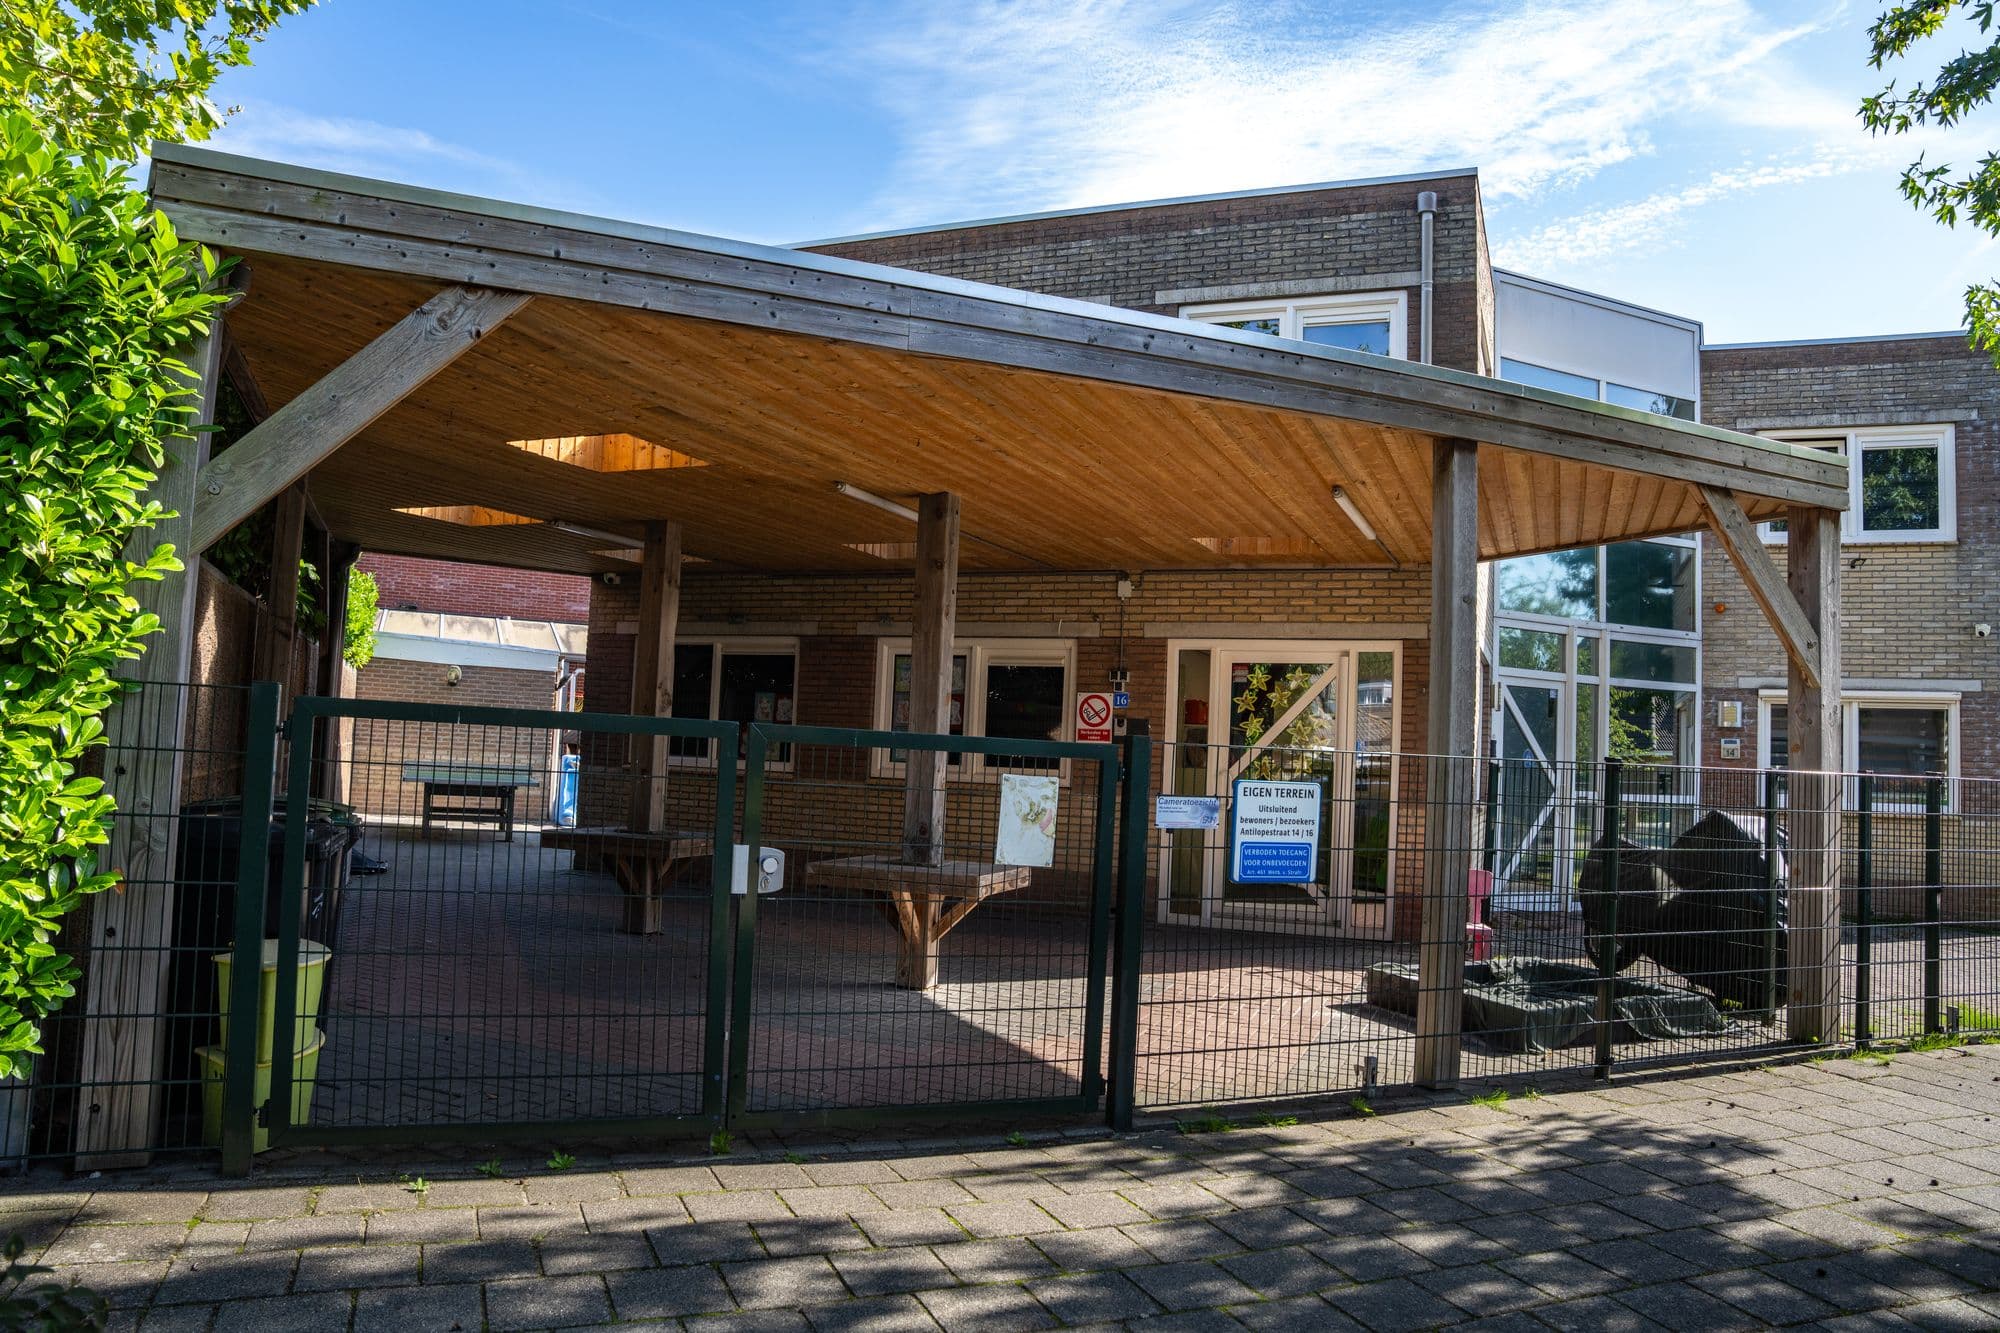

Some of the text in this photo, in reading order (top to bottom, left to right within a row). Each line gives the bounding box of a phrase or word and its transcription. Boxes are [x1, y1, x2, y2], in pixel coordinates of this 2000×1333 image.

[1116, 696, 1127, 705] 16
[1726, 748, 1734, 756] 14
[1243, 786, 1315, 799] EIGEN TERREIN
[1158, 798, 1216, 806] Cameratoezicht
[1258, 805, 1297, 814] Uitsluitend
[1279, 818, 1315, 826] bezoekers
[1240, 828, 1290, 837] Antilopestraat
